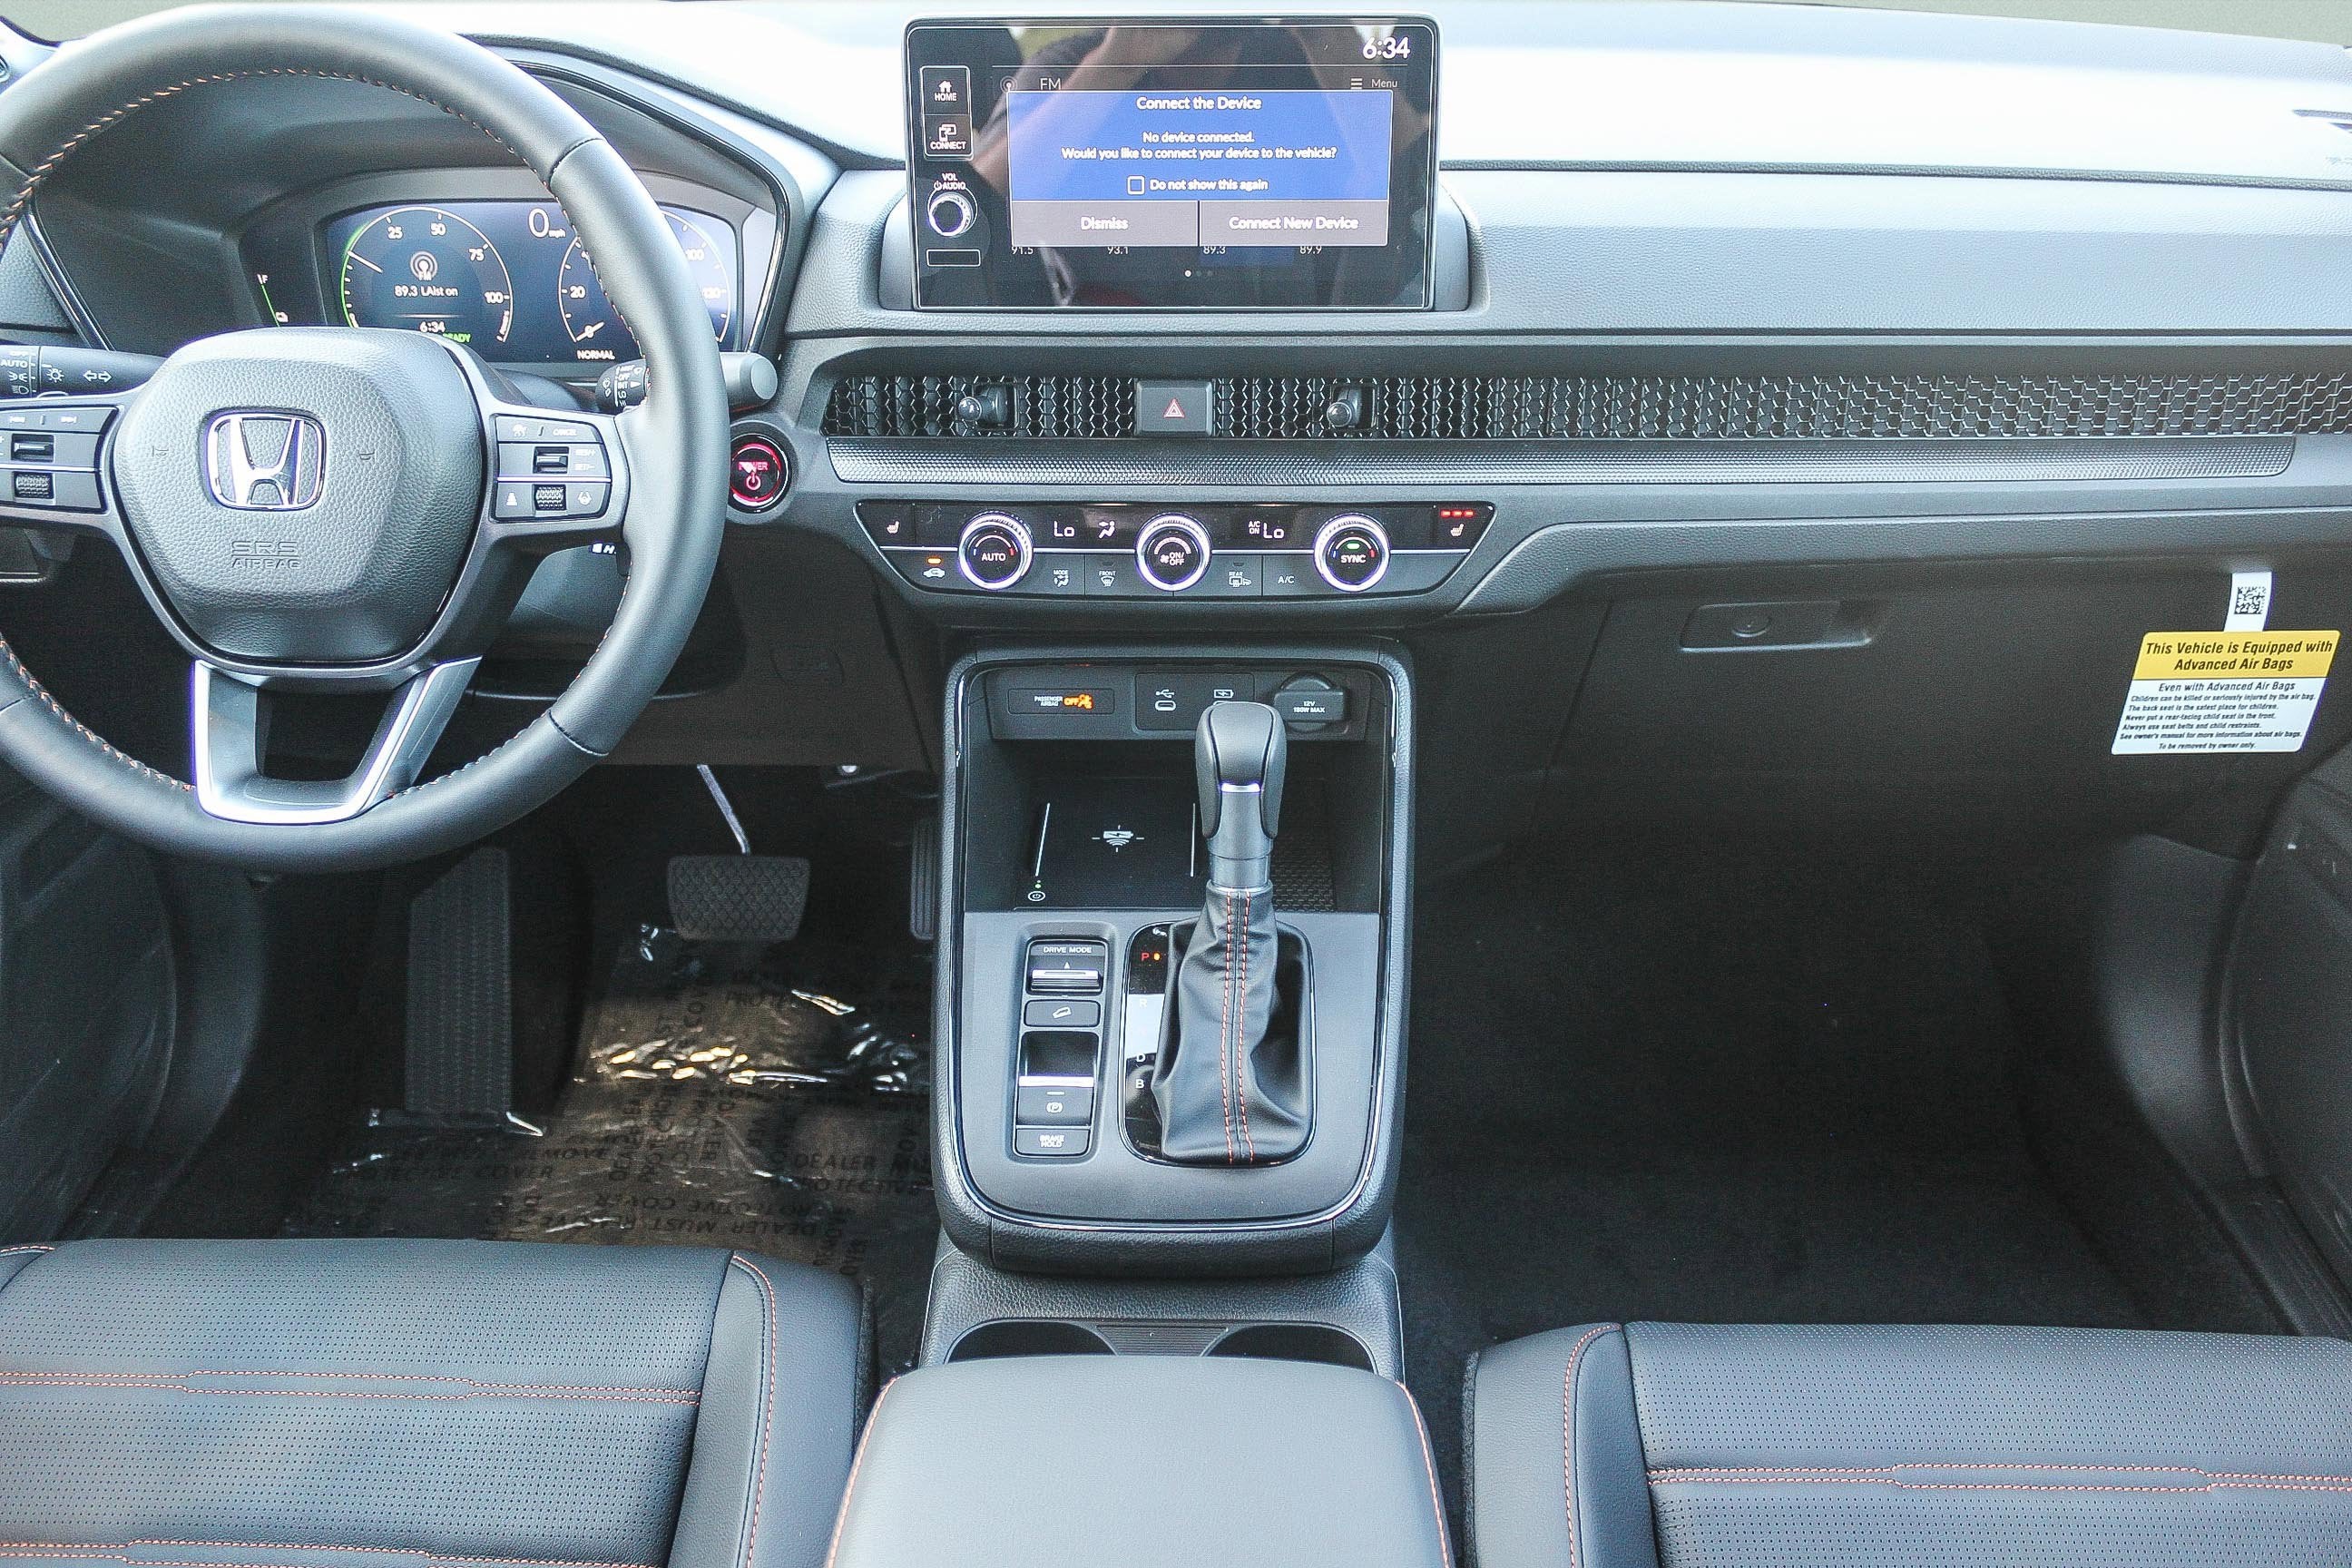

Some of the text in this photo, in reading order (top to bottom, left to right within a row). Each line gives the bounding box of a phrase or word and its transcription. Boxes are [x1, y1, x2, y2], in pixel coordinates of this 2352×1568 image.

[1362, 36, 1411, 60] 6:34
[1040, 78, 1062, 90] FM
[1371, 78, 1398, 88] Menu
[934, 93, 957, 102] HOME
[1136, 95, 1262, 110] Connect the Device
[1142, 131, 1255, 143] No device connected.
[930, 141, 966, 150] CONNECT
[1061, 147, 1338, 161] Would you like to connect your device to the vehicle?
[942, 173, 957, 181] VOL
[942, 181, 966, 191] AUDIO
[1150, 179, 1269, 191] Do not show this again
[528, 208, 550, 238] 0
[1081, 217, 1129, 230] Dismiss
[1229, 217, 1358, 230] Connect New Device
[387, 227, 403, 240] 25
[430, 223, 446, 236] 50
[468, 248, 485, 261] 75
[1011, 246, 1034, 255] 91.5
[1107, 246, 1129, 255] 93.1
[1203, 246, 1226, 255] 89.3
[1299, 246, 1322, 255] 89.9
[395, 286, 418, 297] 89.3
[447, 288, 458, 296] on
[569, 285, 586, 299] 20
[485, 292, 504, 304] 100
[419, 321, 446, 332] 6:34
[577, 350, 615, 360] NORMAL
[981, 553, 1006, 562] AUTO
[1340, 554, 1367, 564] SYNC
[1277, 575, 1295, 583] A/C
[2146, 641, 2333, 655] This Vehicle is Equipped with
[2174, 658, 2294, 671] Advanced Air Bags
[2159, 681, 2296, 691] Even with Advanced Air Bags
[1063, 697, 1079, 706] OFF
[2212, 694, 2243, 702] seriously
[2269, 693, 2277, 701] by
[1142, 953, 1150, 961] P
[1140, 998, 1148, 1008] R
[1136, 1053, 1146, 1063] D
[1135, 1079, 1145, 1089] B
